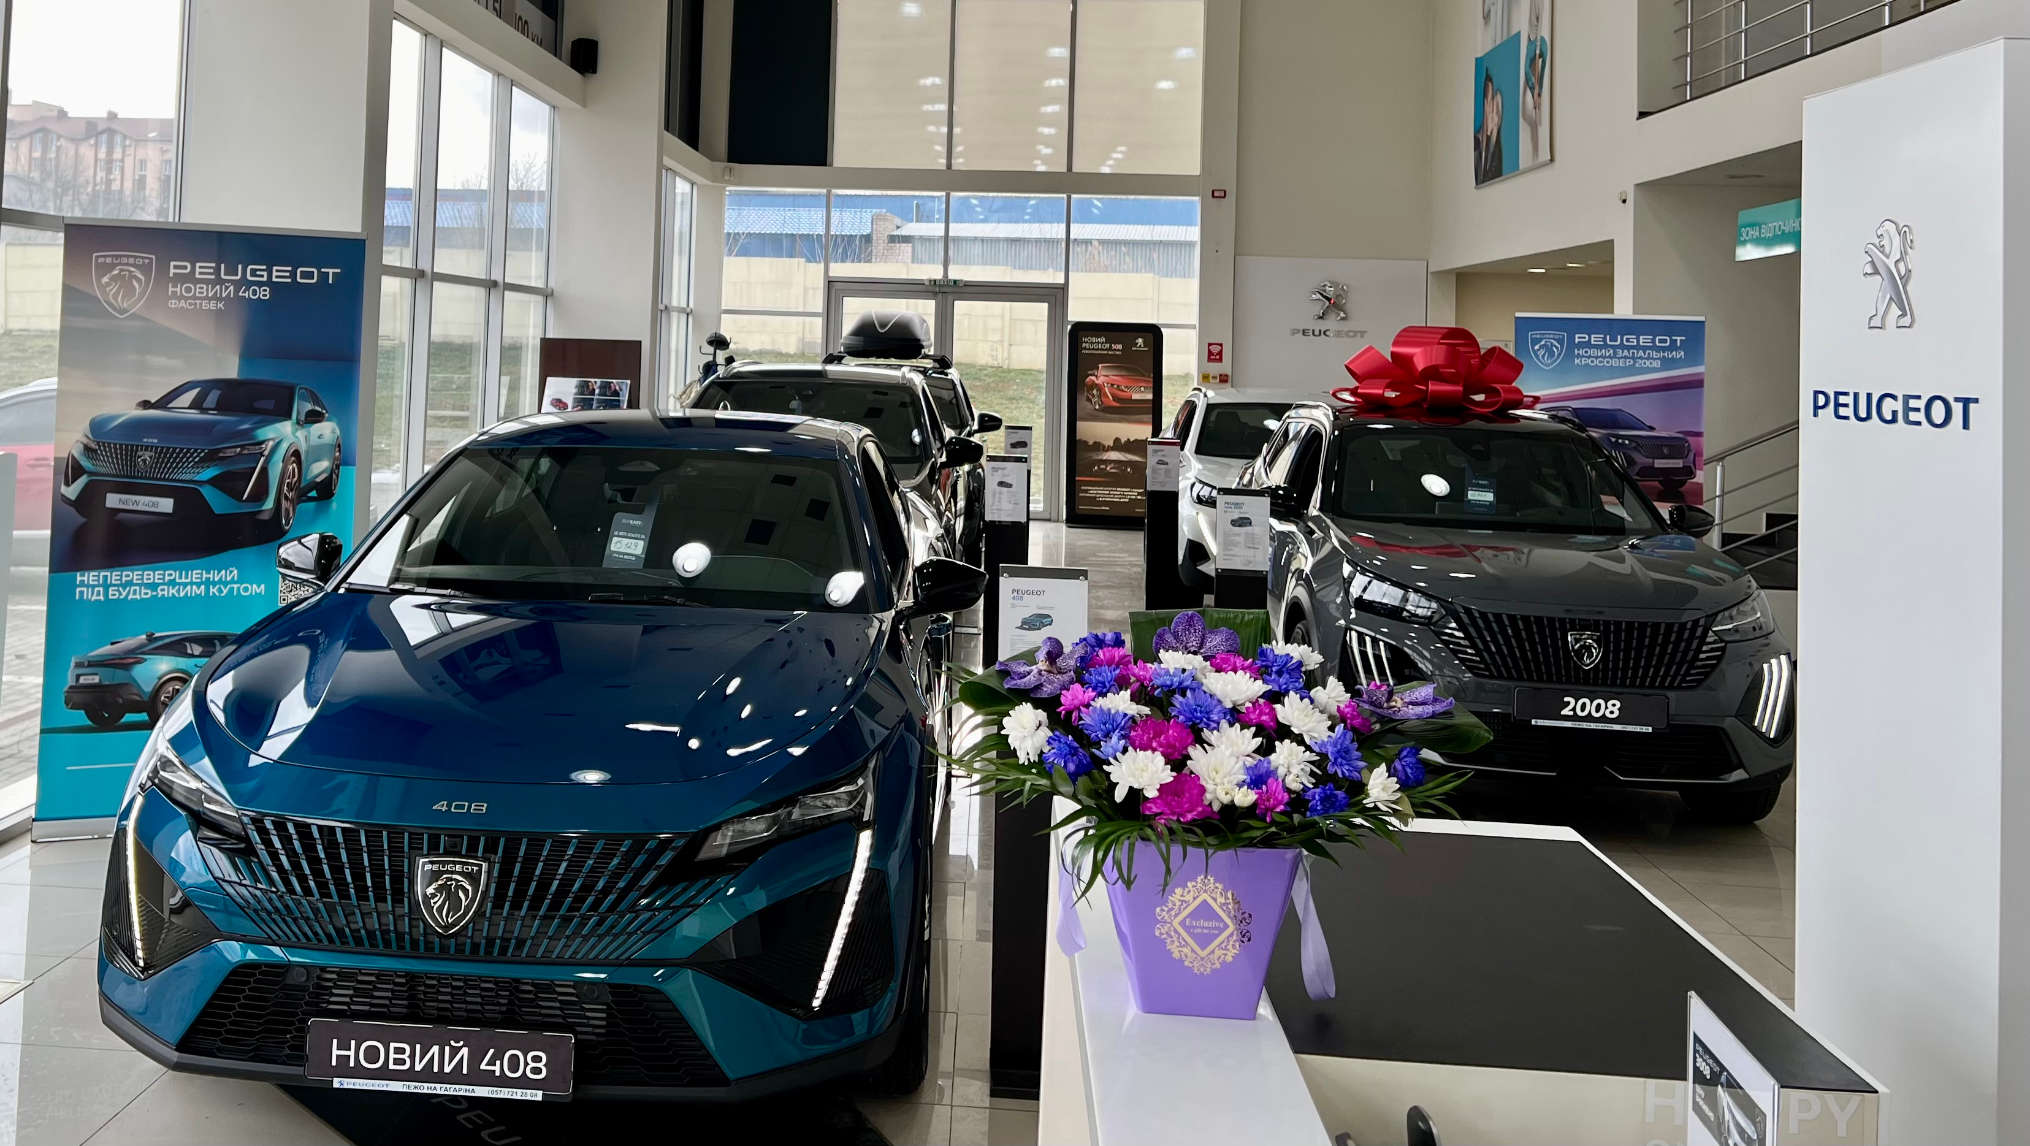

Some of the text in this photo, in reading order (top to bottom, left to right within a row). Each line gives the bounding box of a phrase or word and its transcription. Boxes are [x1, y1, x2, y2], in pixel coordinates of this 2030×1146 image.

[1740, 226, 1760, 241] ЗОНА
[97, 257, 150, 265] PEUGEOT
[169, 261, 341, 284] PEUGEOT
[168, 282, 270, 300] НОВИЙ 408
[168, 300, 225, 310] ФАСТБЕК
[1289, 328, 1368, 339] PEUGEOT
[1574, 333, 1687, 347] PEUGEOT
[1574, 347, 1685, 359] НОВИЙ ЗАПАЛЬНИЙ
[1574, 357, 1661, 368] КРОСОВЕР 2008
[1812, 389, 1980, 431] PEUGEOT
[118, 497, 160, 509] NEW 408
[76, 567, 238, 585] НЕПЕРЕВЕРШЕНИЙ
[75, 583, 265, 601] ПІД БУДЬ-ЯКИМ КУТОМ
[1011, 588, 1046, 596] PEUGEOT
[1560, 696, 1621, 719] 2008
[432, 801, 487, 814] 408
[424, 863, 479, 873] PEUGEOT
[331, 1038, 548, 1080] НОВИЙ 408
[346, 1080, 390, 1089] PEUGEOT
[402, 1083, 425, 1091] ПЕЖО
[439, 1086, 476, 1094] ГАГАРІНА
